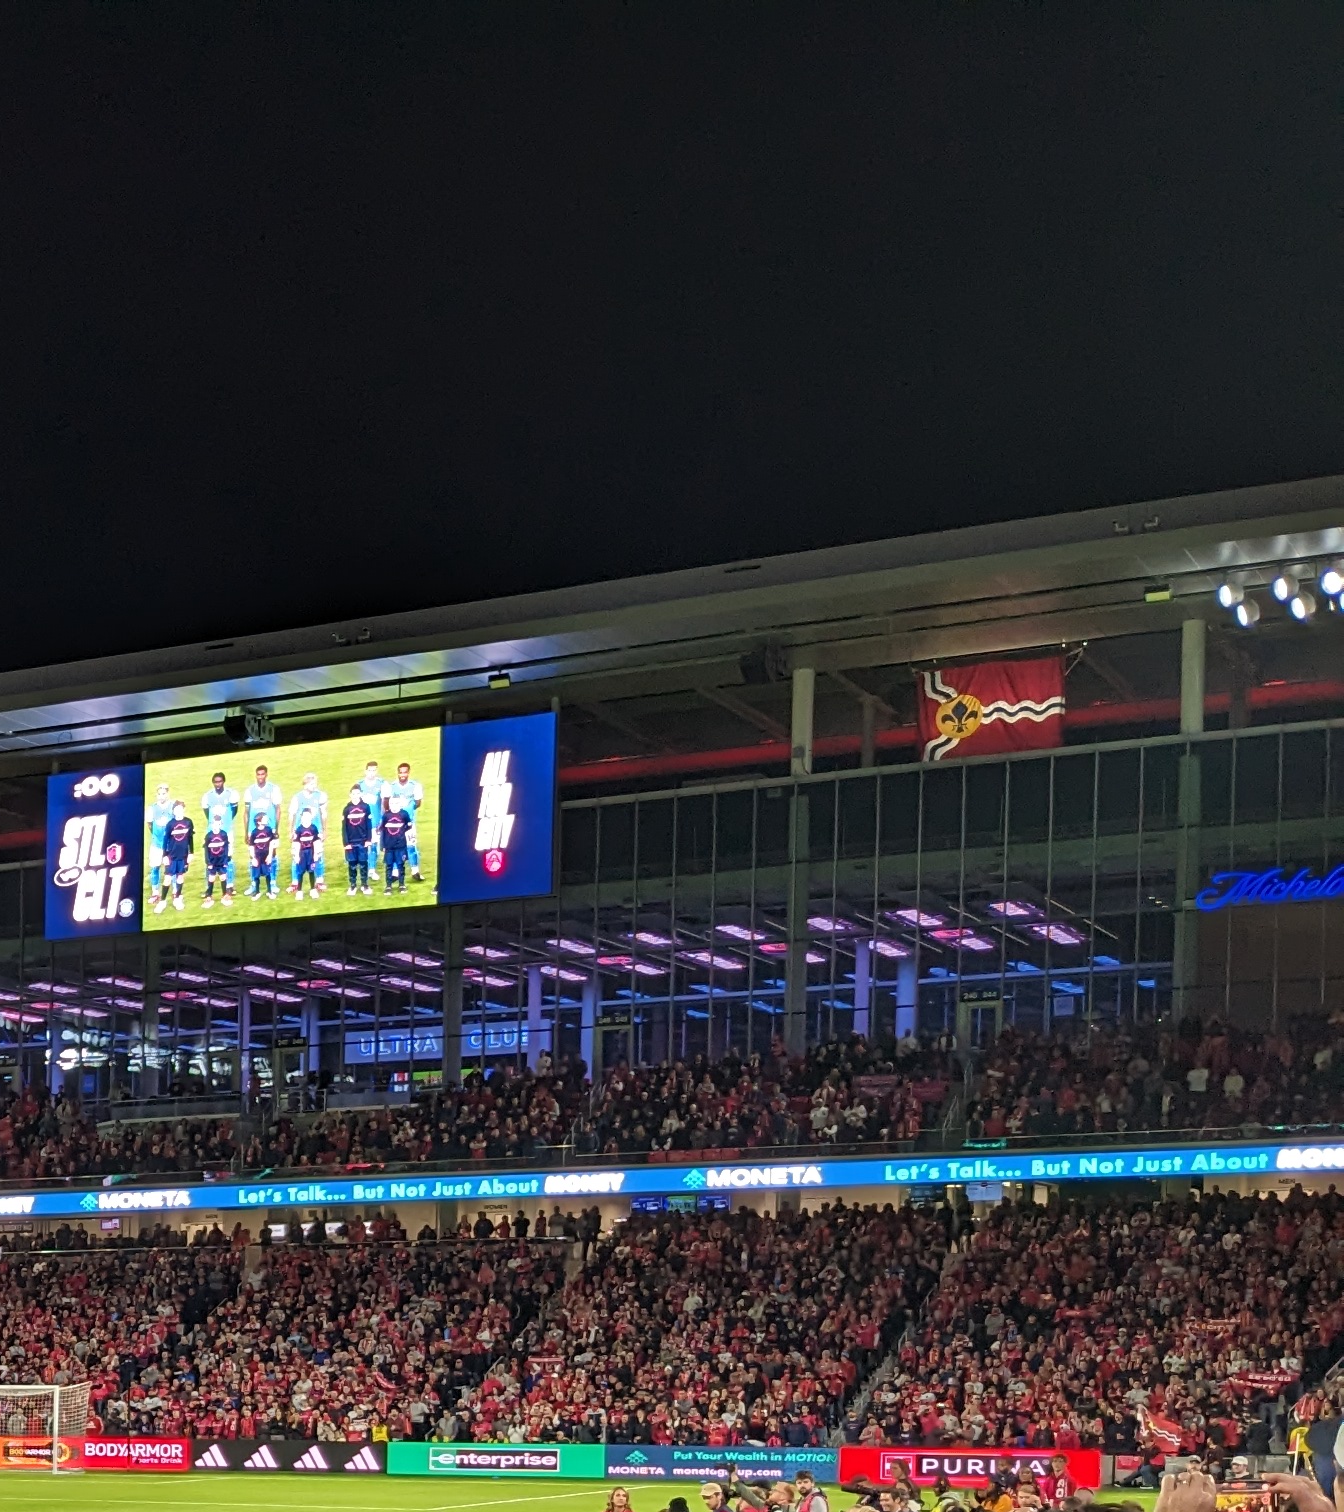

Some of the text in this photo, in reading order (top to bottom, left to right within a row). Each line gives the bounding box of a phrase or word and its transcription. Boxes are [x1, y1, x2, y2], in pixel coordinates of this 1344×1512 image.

[59, 813, 108, 867] STL
[73, 865, 128, 922] CLT
[359, 1032, 438, 1056] ULTRA
[706, 1166, 822, 1187] MONETA
[885, 1164, 940, 1181] Let's
[947, 1160, 1021, 1179] Talk...
[1031, 1159, 1070, 1176] But
[1079, 1157, 1124, 1174] Not
[1132, 1156, 1182, 1173] Just
[1190, 1152, 1268, 1171] About
[98, 1190, 191, 1210] MONETA
[238, 1189, 282, 1204] Let's
[287, 1185, 346, 1202] Talk...
[353, 1184, 384, 1199] But
[390, 1182, 427, 1198] Not
[432, 1181, 471, 1197] Just
[477, 1178, 539, 1195] About
[84, 1443, 183, 1458] BODYARMOR
[432, 1452, 557, 1469] enterprise
[673, 1451, 837, 1463] Put Your Wealth in MOTION
[608, 1466, 665, 1475] MONETA
[673, 1467, 782, 1478] monetagup.com
